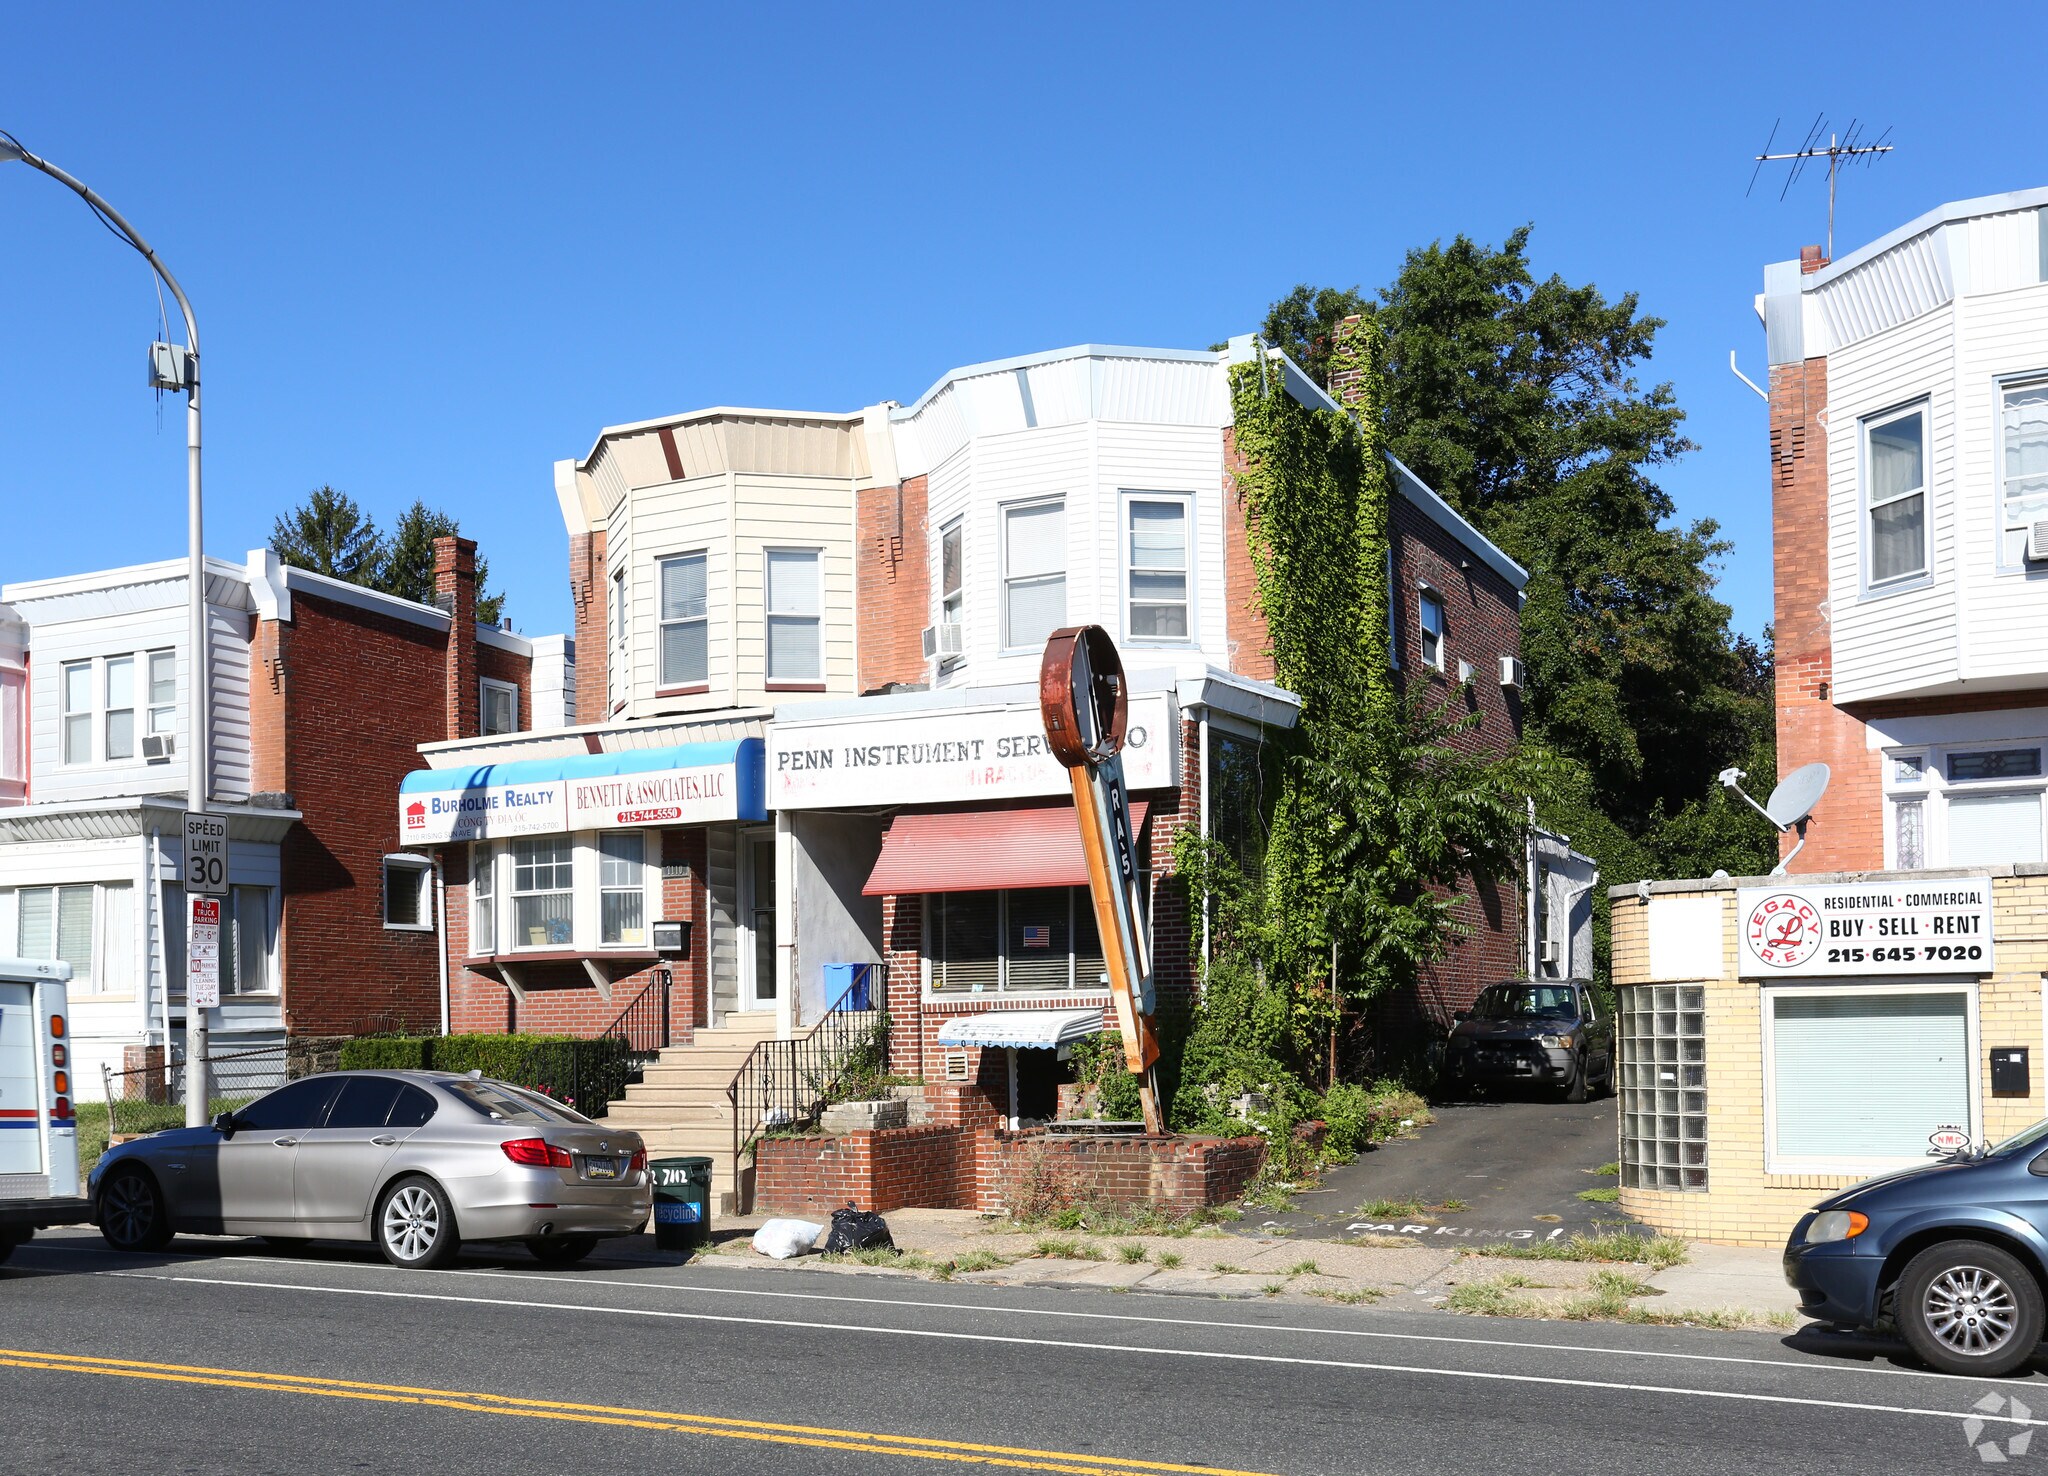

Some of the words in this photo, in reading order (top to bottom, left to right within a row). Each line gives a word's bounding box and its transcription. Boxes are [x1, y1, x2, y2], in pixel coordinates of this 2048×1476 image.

[778, 749, 834, 772] PENN
[844, 739, 984, 768] INSTRUMENT
[577, 783, 622, 810] BENNETT
[626, 782, 634, 806] &
[636, 776, 702, 804] ASSOCIATES,
[704, 772, 724, 798] LLC
[432, 796, 498, 814] BURHOLME
[506, 790, 554, 807] REALTY
[408, 816, 426, 824] BR
[484, 816, 496, 826] TY
[621, 807, 678, 822] 215-744-5550
[188, 822, 224, 836] SPEED
[514, 822, 559, 832] 215-742-5700
[421, 832, 442, 840] RISING
[444, 830, 458, 838] SUN
[459, 829, 472, 837] AVE
[192, 839, 220, 852] LIMIT
[190, 856, 222, 884] 30
[1824, 894, 1894, 910] RESIDENTIAL
[1906, 892, 1982, 907] COMMERCIAL
[197, 908, 215, 916] TRUCK
[1751, 898, 1819, 938] LEGACY
[194, 916, 218, 924] PARKING
[1830, 918, 1864, 938] BUY
[1879, 917, 1919, 936] SELL
[1934, 915, 1980, 934] RENT
[1760, 949, 1804, 963] R.E.
[192, 960, 200, 971] NO
[960, 1039, 1034, 1048] OFFICE
[1938, 1136, 1962, 1144] NMC
[662, 1168, 688, 1186] 7112
[656, 1205, 698, 1222] recycling
